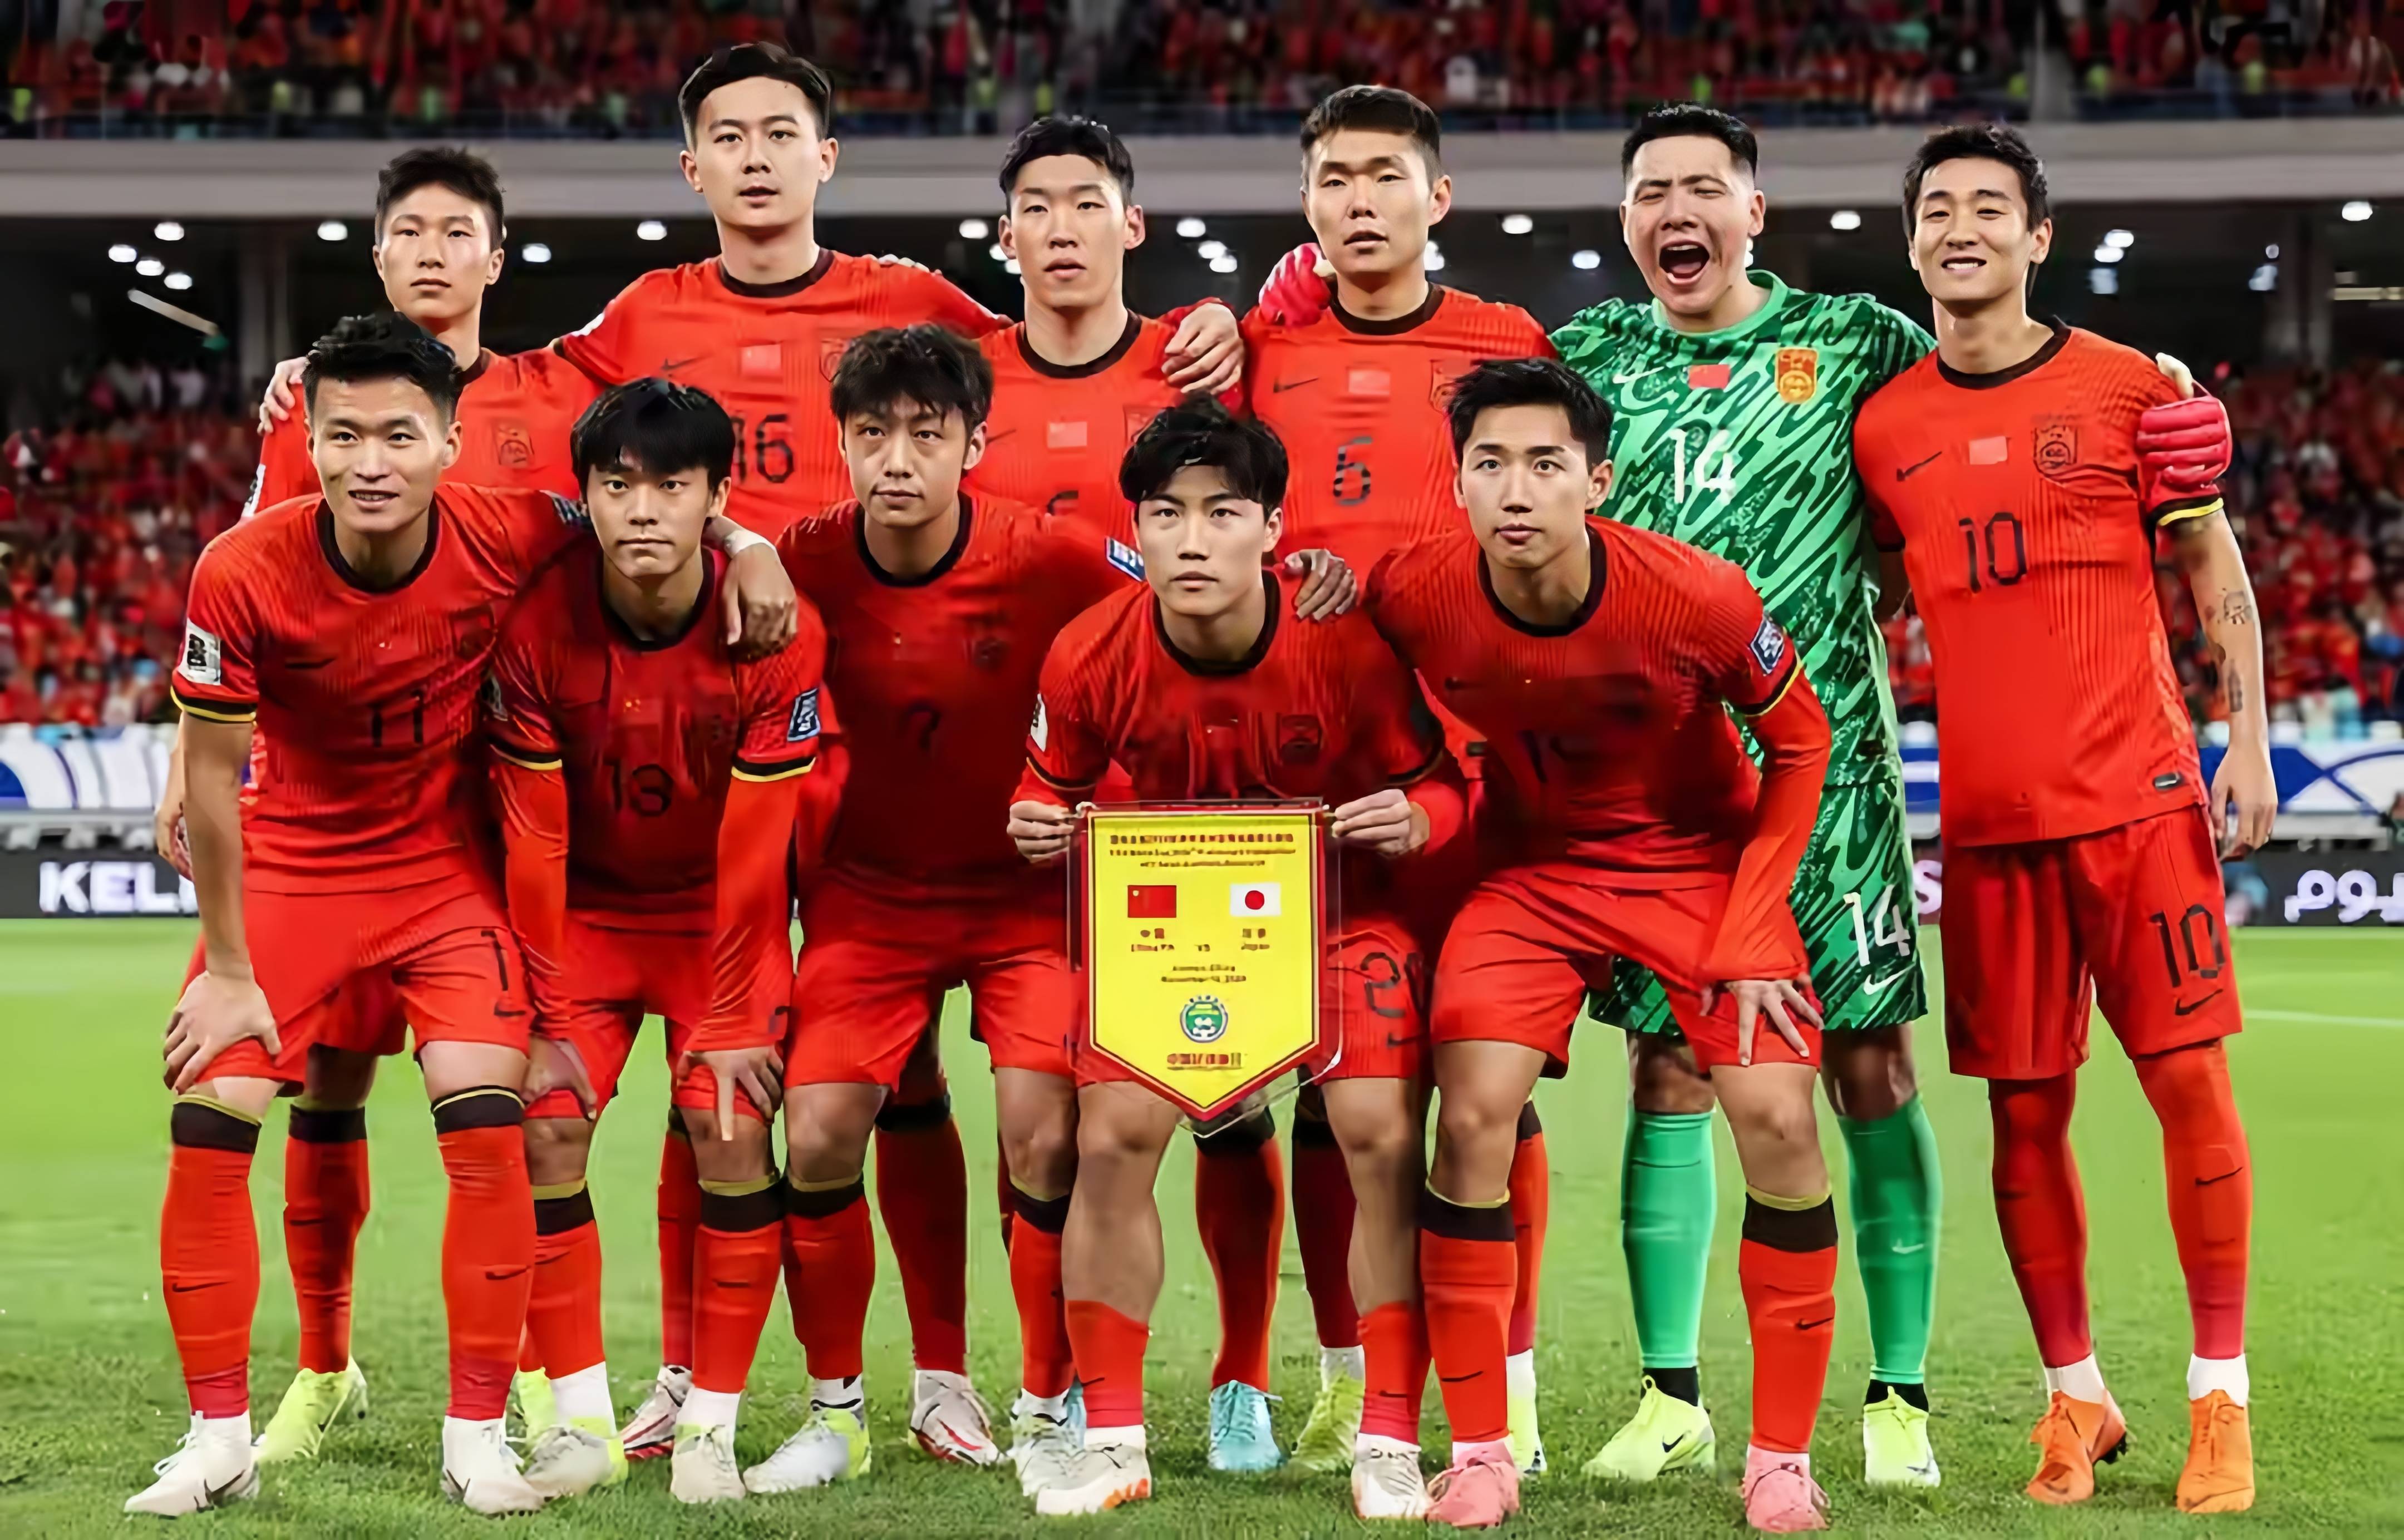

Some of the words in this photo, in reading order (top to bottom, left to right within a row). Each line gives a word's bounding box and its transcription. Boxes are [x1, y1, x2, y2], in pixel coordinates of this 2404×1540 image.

[731, 413, 793, 483] 16
[1669, 428, 1736, 504] 14
[1959, 512, 2027, 593] 10
[1843, 885, 1911, 966] 14
[2149, 904, 2225, 988] 10
